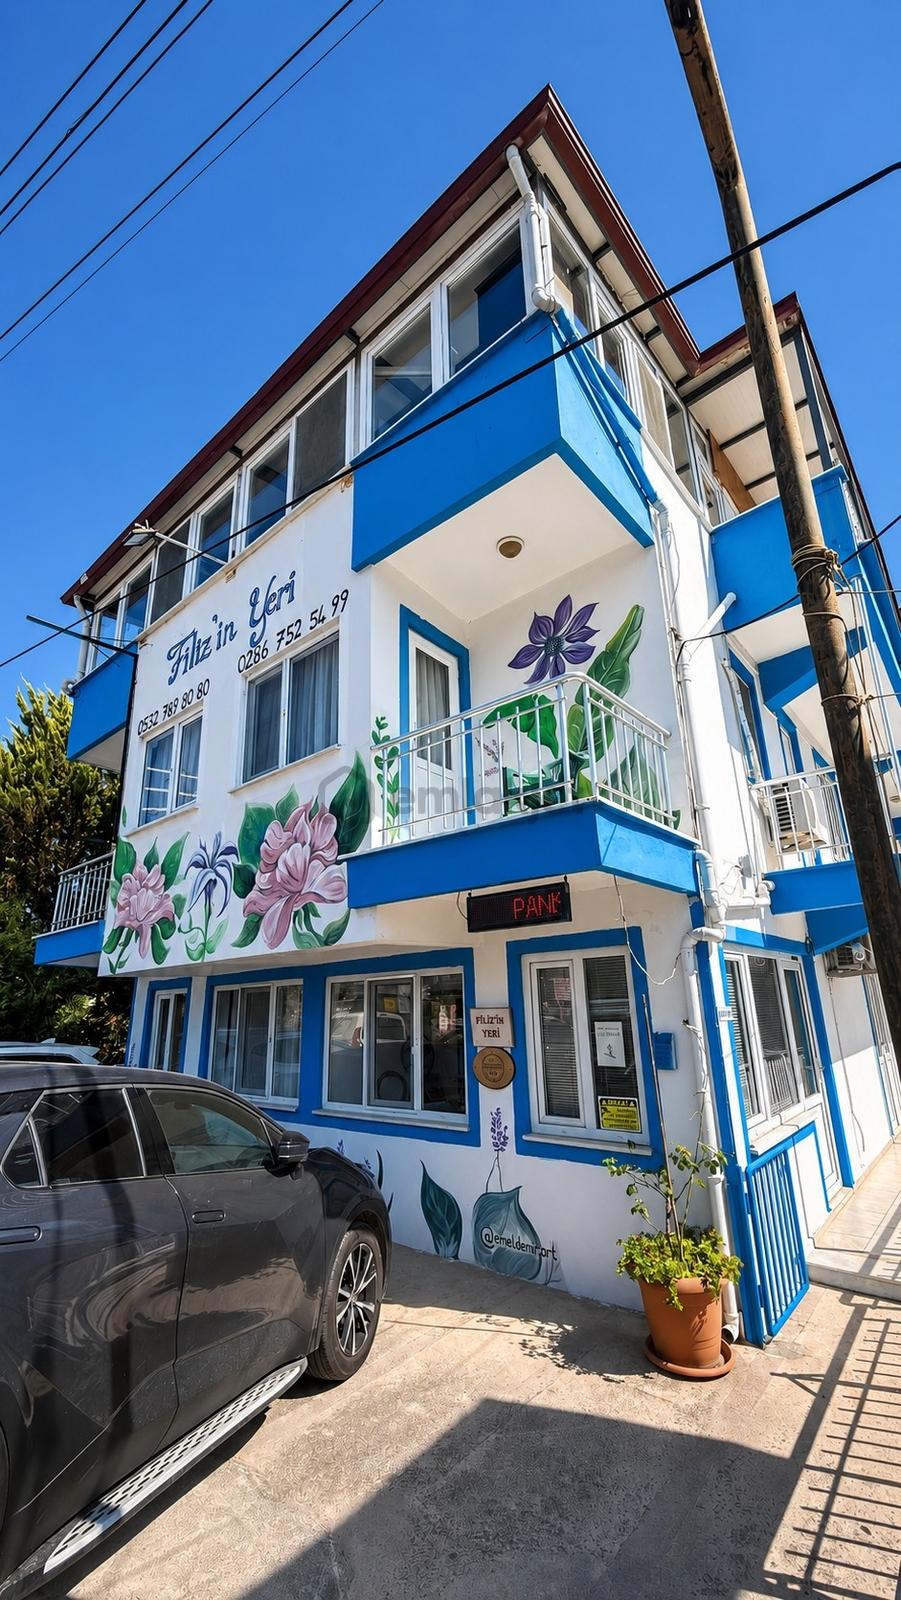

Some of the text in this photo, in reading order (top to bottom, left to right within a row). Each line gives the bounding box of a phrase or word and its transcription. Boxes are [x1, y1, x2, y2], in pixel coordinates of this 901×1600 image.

[237, 588, 349, 674] 0286 752 54 99
[248, 570, 296, 648] Yeri
[137, 678, 210, 736] 0532 789 80 80
[481, 1027, 501, 1038] YERİ
